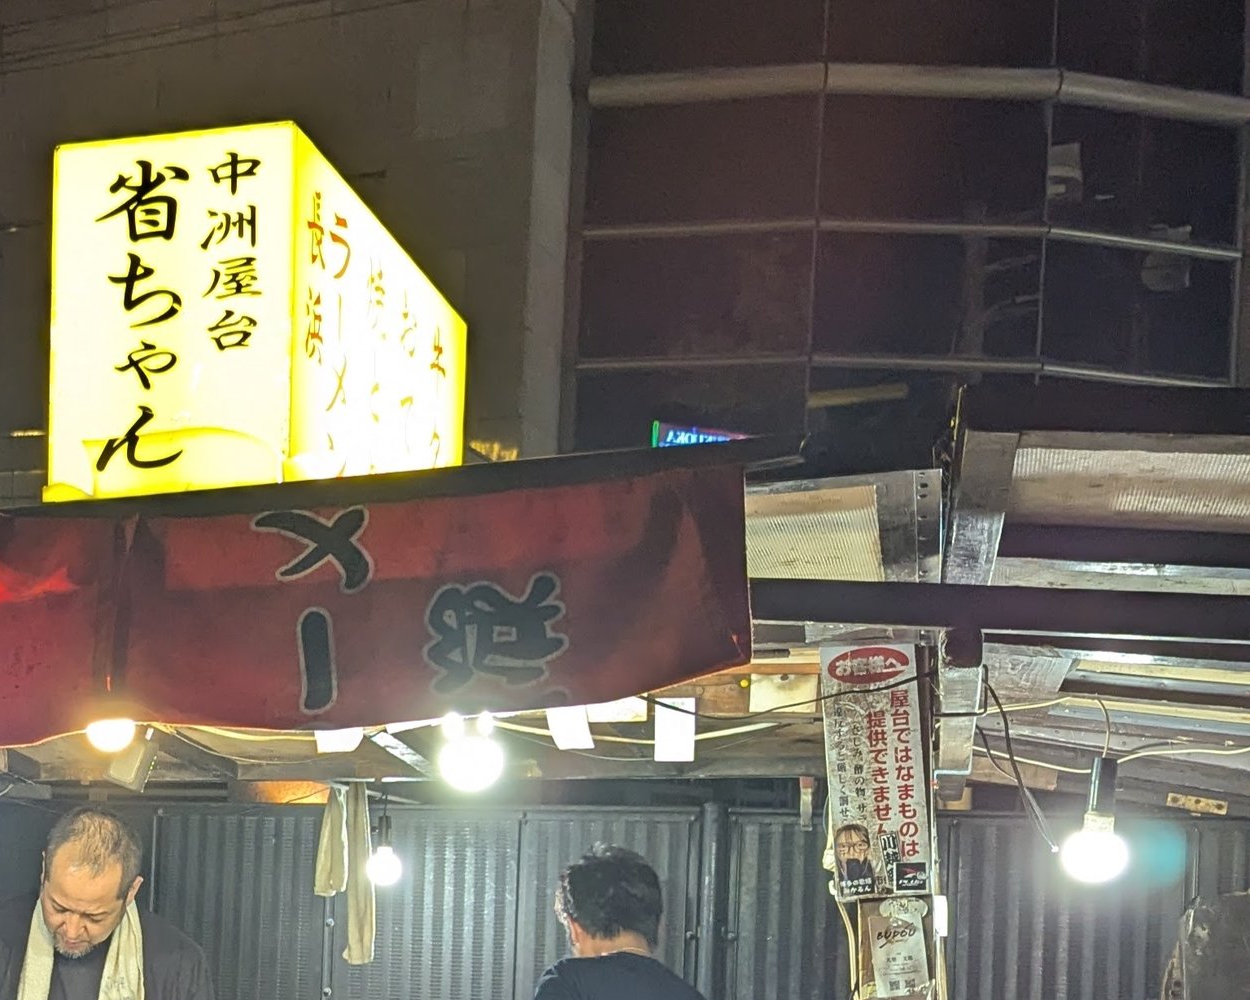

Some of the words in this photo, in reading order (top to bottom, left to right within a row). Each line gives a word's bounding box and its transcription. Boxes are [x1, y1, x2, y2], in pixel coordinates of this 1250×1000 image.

[95, 160, 190, 472] 省ちゃん
[201, 151, 263, 351] 中洲屋台
[304, 190, 326, 366] 長浜
[889, 689, 920, 858] 屋台ではなまものは
